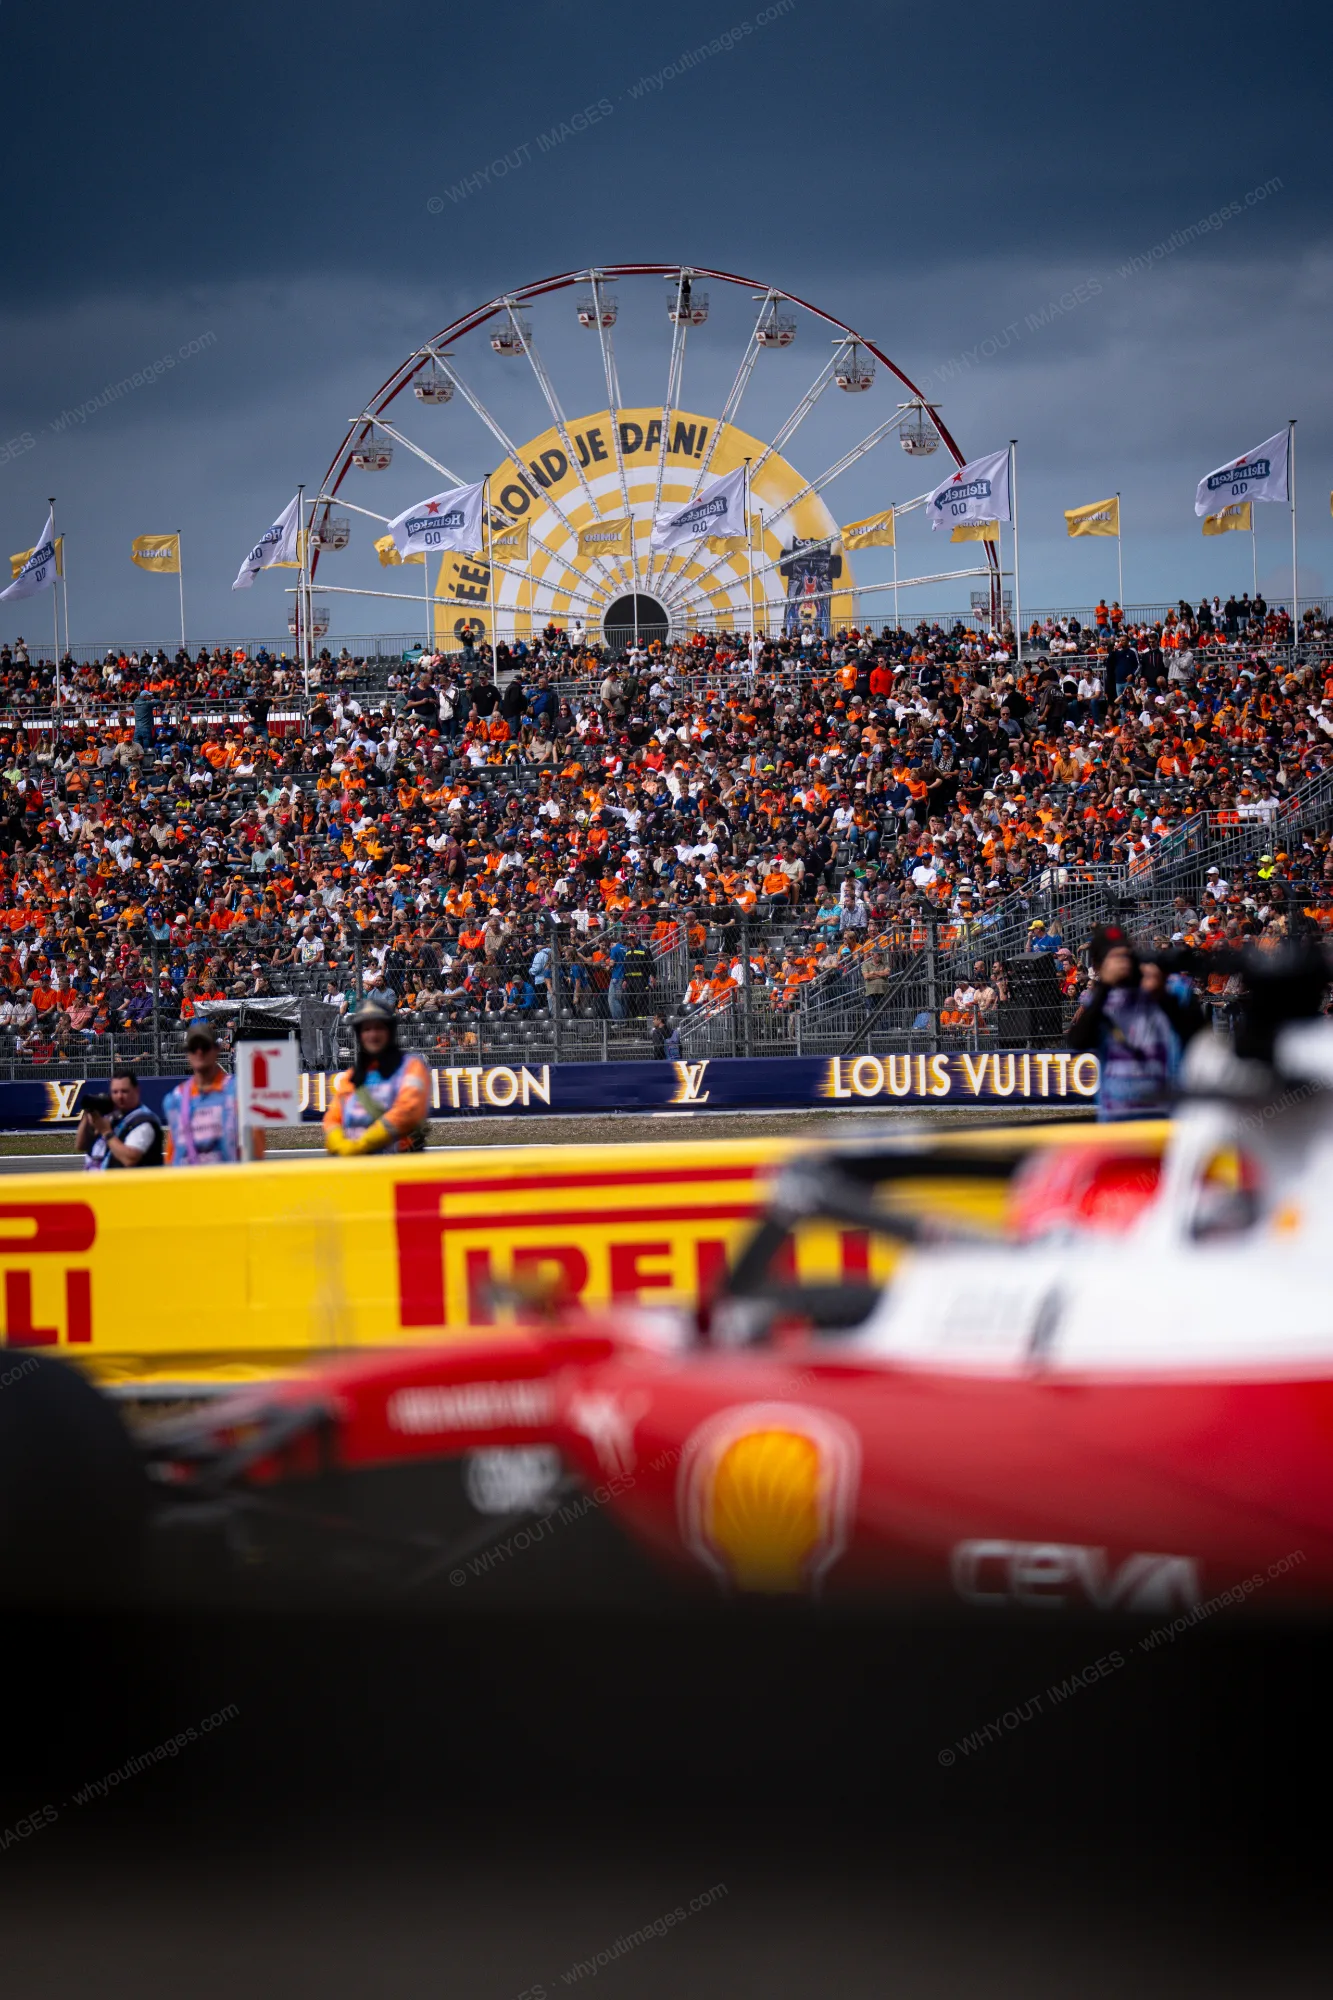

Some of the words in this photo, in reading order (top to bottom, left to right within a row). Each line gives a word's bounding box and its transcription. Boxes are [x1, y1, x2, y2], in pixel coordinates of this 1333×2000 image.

[619, 421, 708, 459] DAN!
[431, 1065, 551, 1108] ITTON
[831, 1054, 951, 1098] LOUIS
[962, 1052, 1100, 1097] VUITTO
